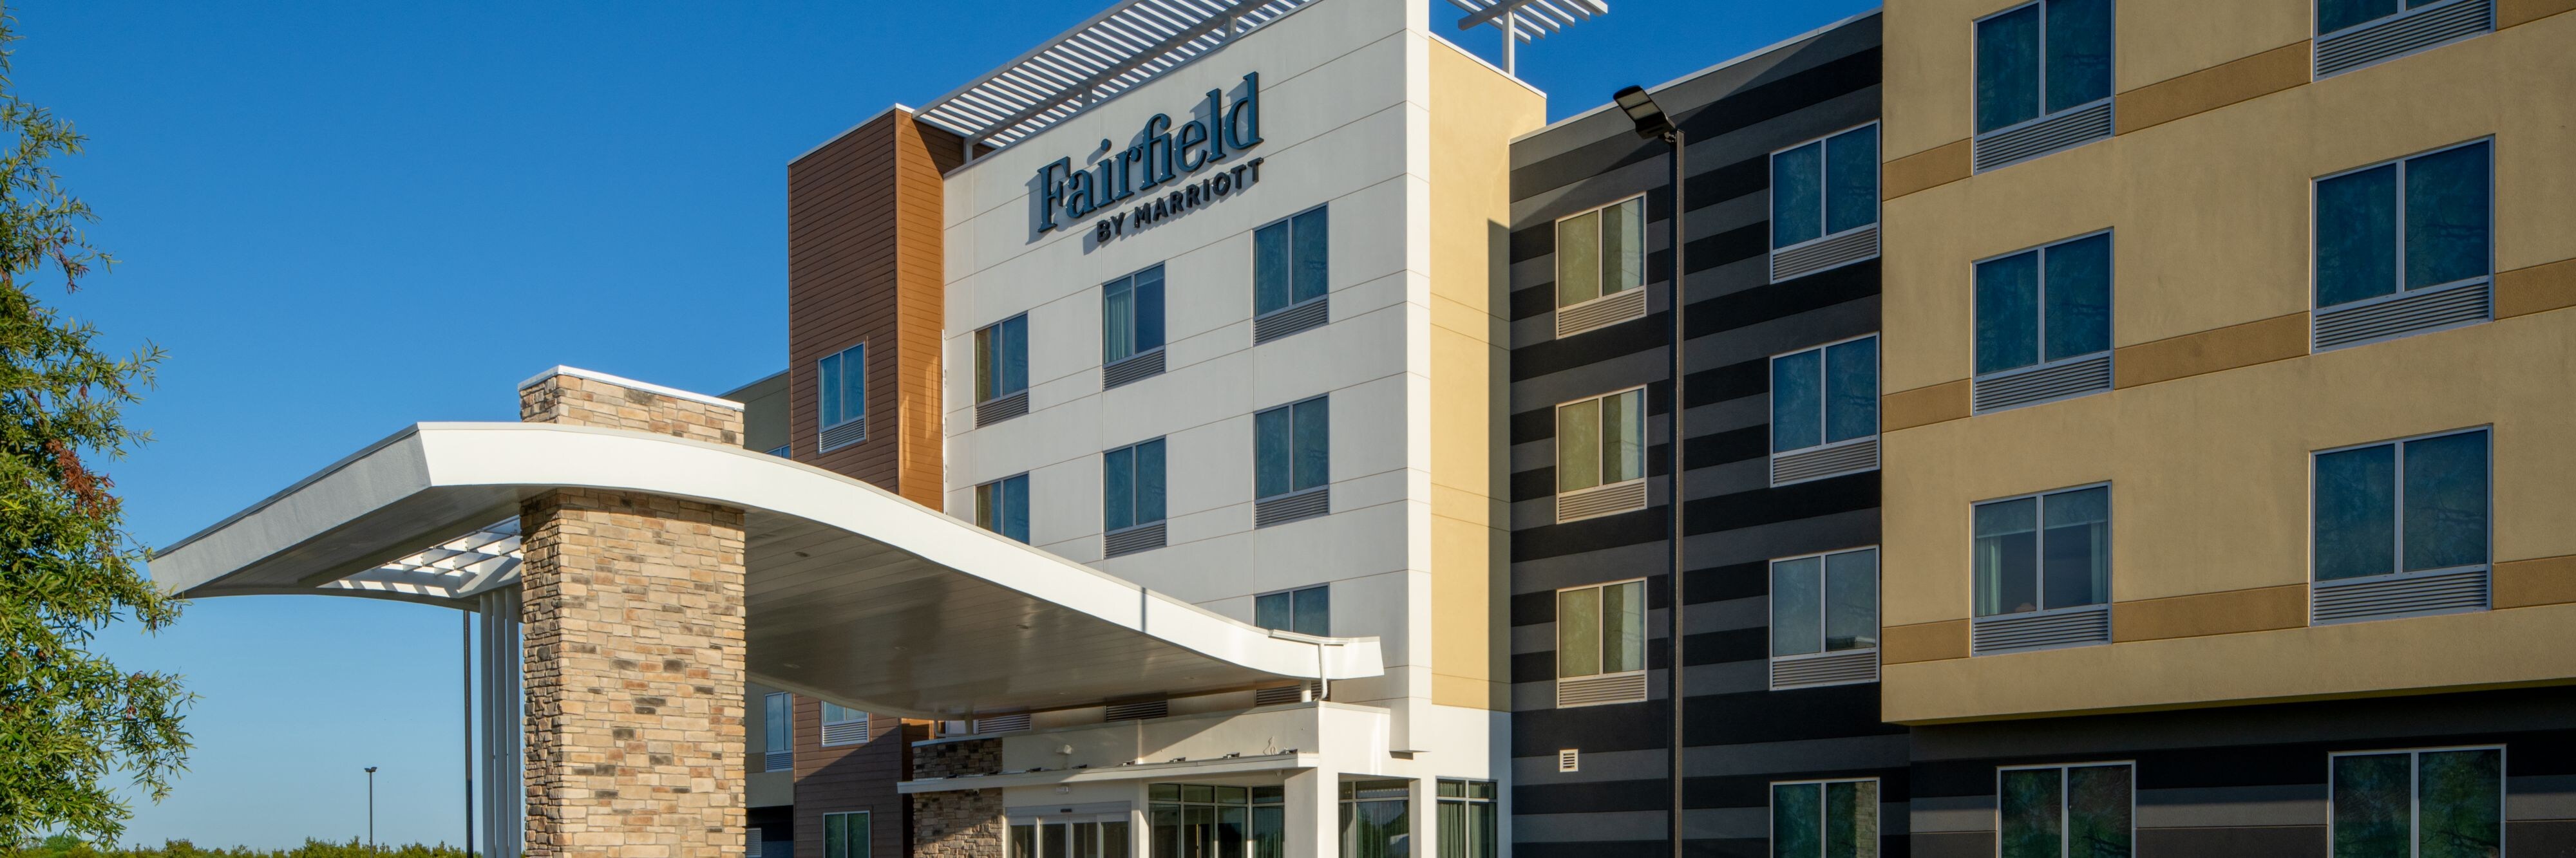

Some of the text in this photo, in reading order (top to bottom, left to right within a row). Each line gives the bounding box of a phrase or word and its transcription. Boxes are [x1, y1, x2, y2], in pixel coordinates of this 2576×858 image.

[1037, 71, 1264, 232] Fairfield
[1097, 157, 1264, 243] BY MARRIOTT
